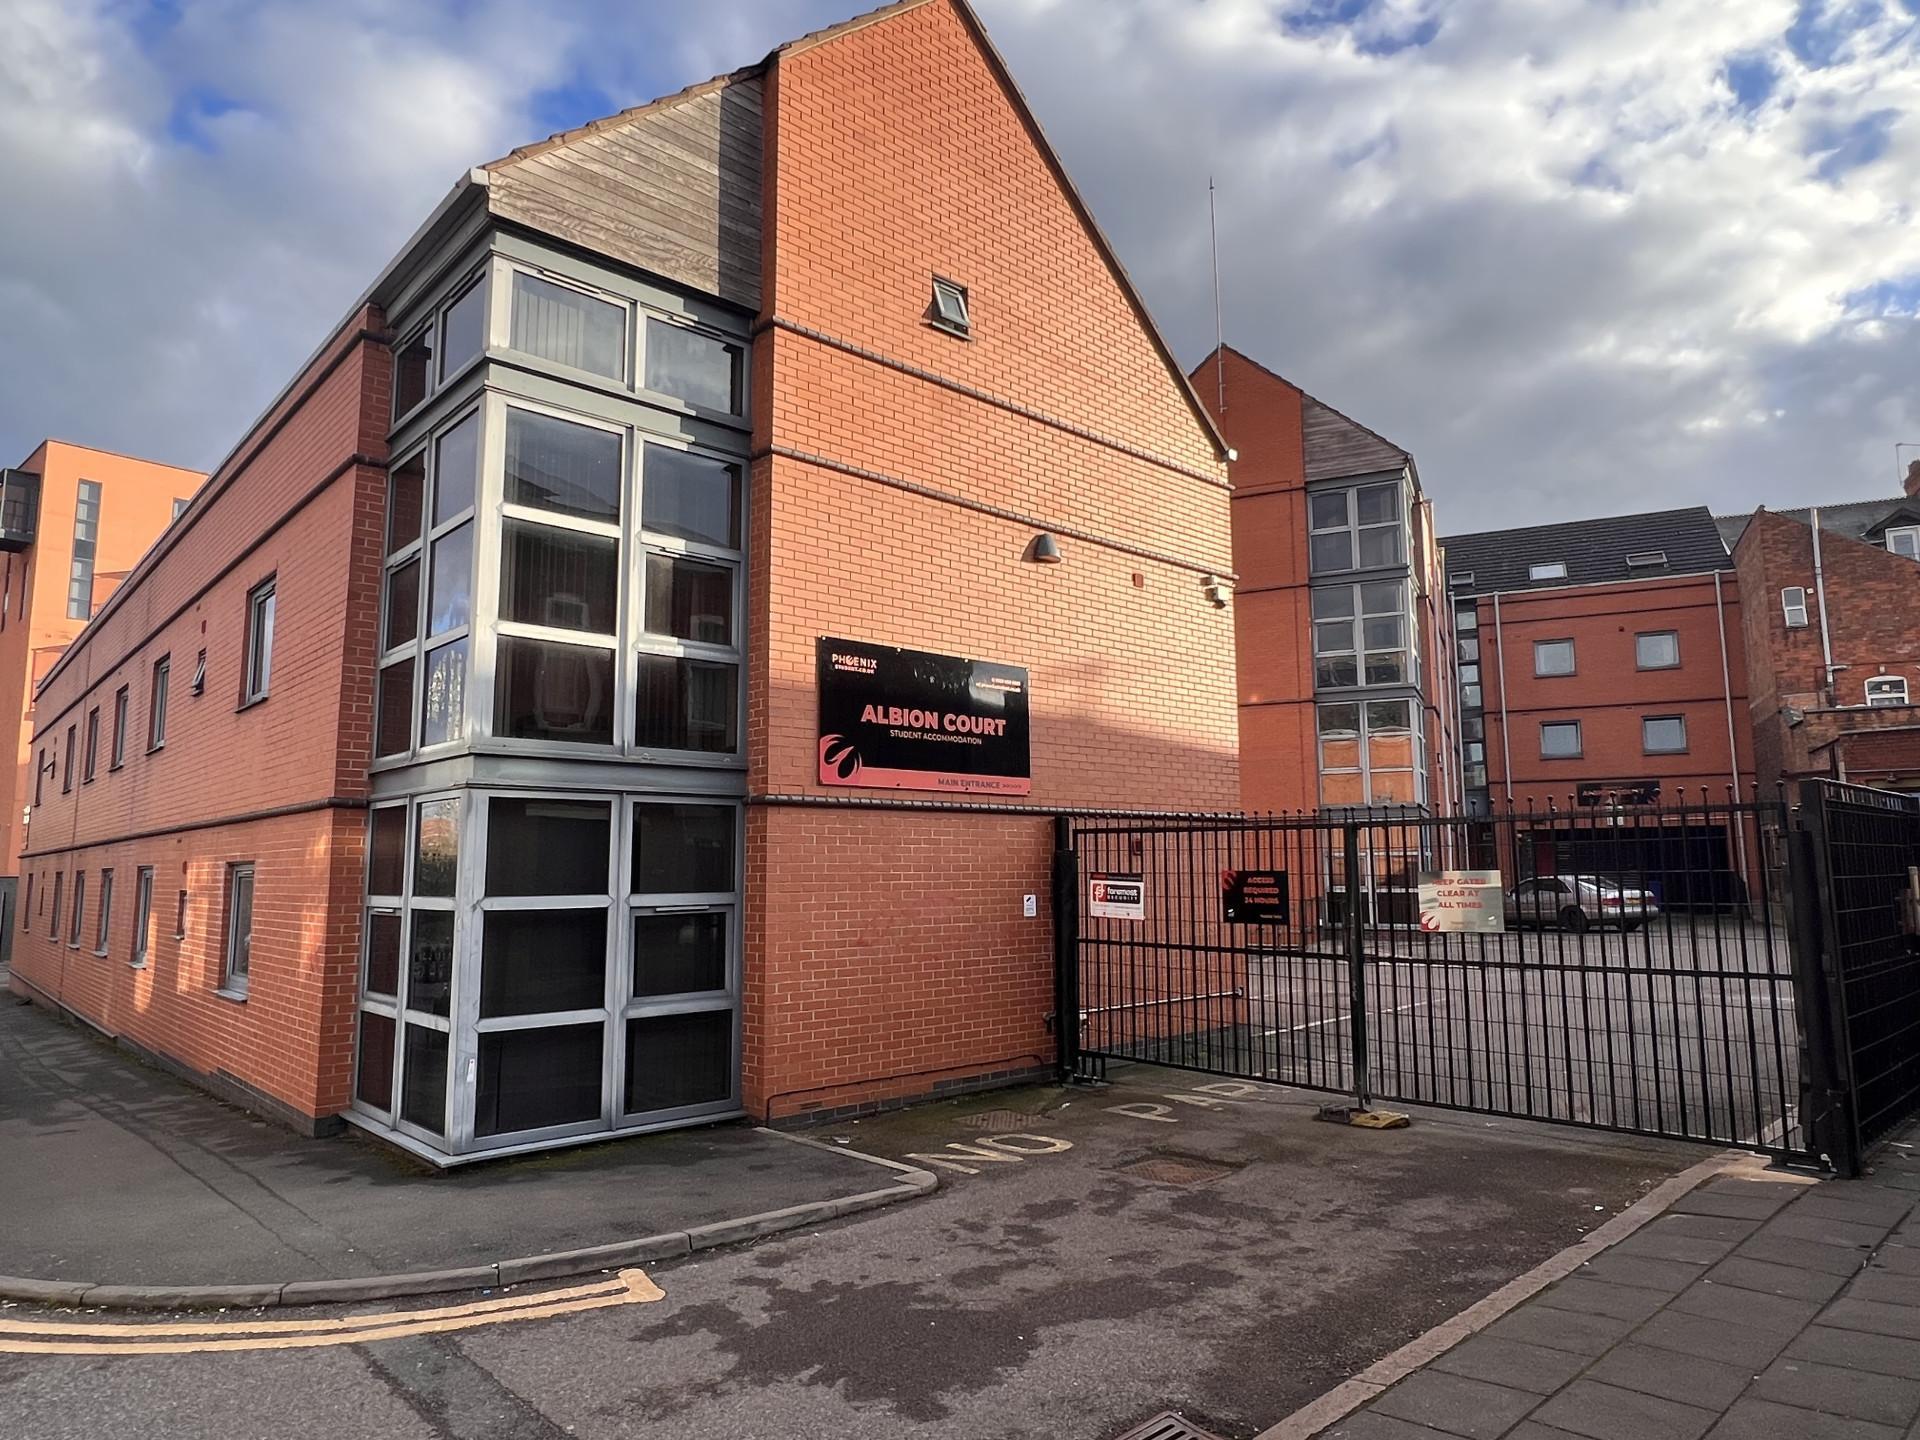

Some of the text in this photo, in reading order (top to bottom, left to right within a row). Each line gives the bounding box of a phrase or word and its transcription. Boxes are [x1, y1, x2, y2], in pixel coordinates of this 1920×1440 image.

[832, 653, 878, 669] PHOENIX
[860, 704, 1007, 736] ALBION COURT
[889, 729, 983, 745] STUDENT ACCOMMODATION
[938, 778, 1001, 790] MAIN ENTRANCE
[1438, 901, 1454, 909] ALL
